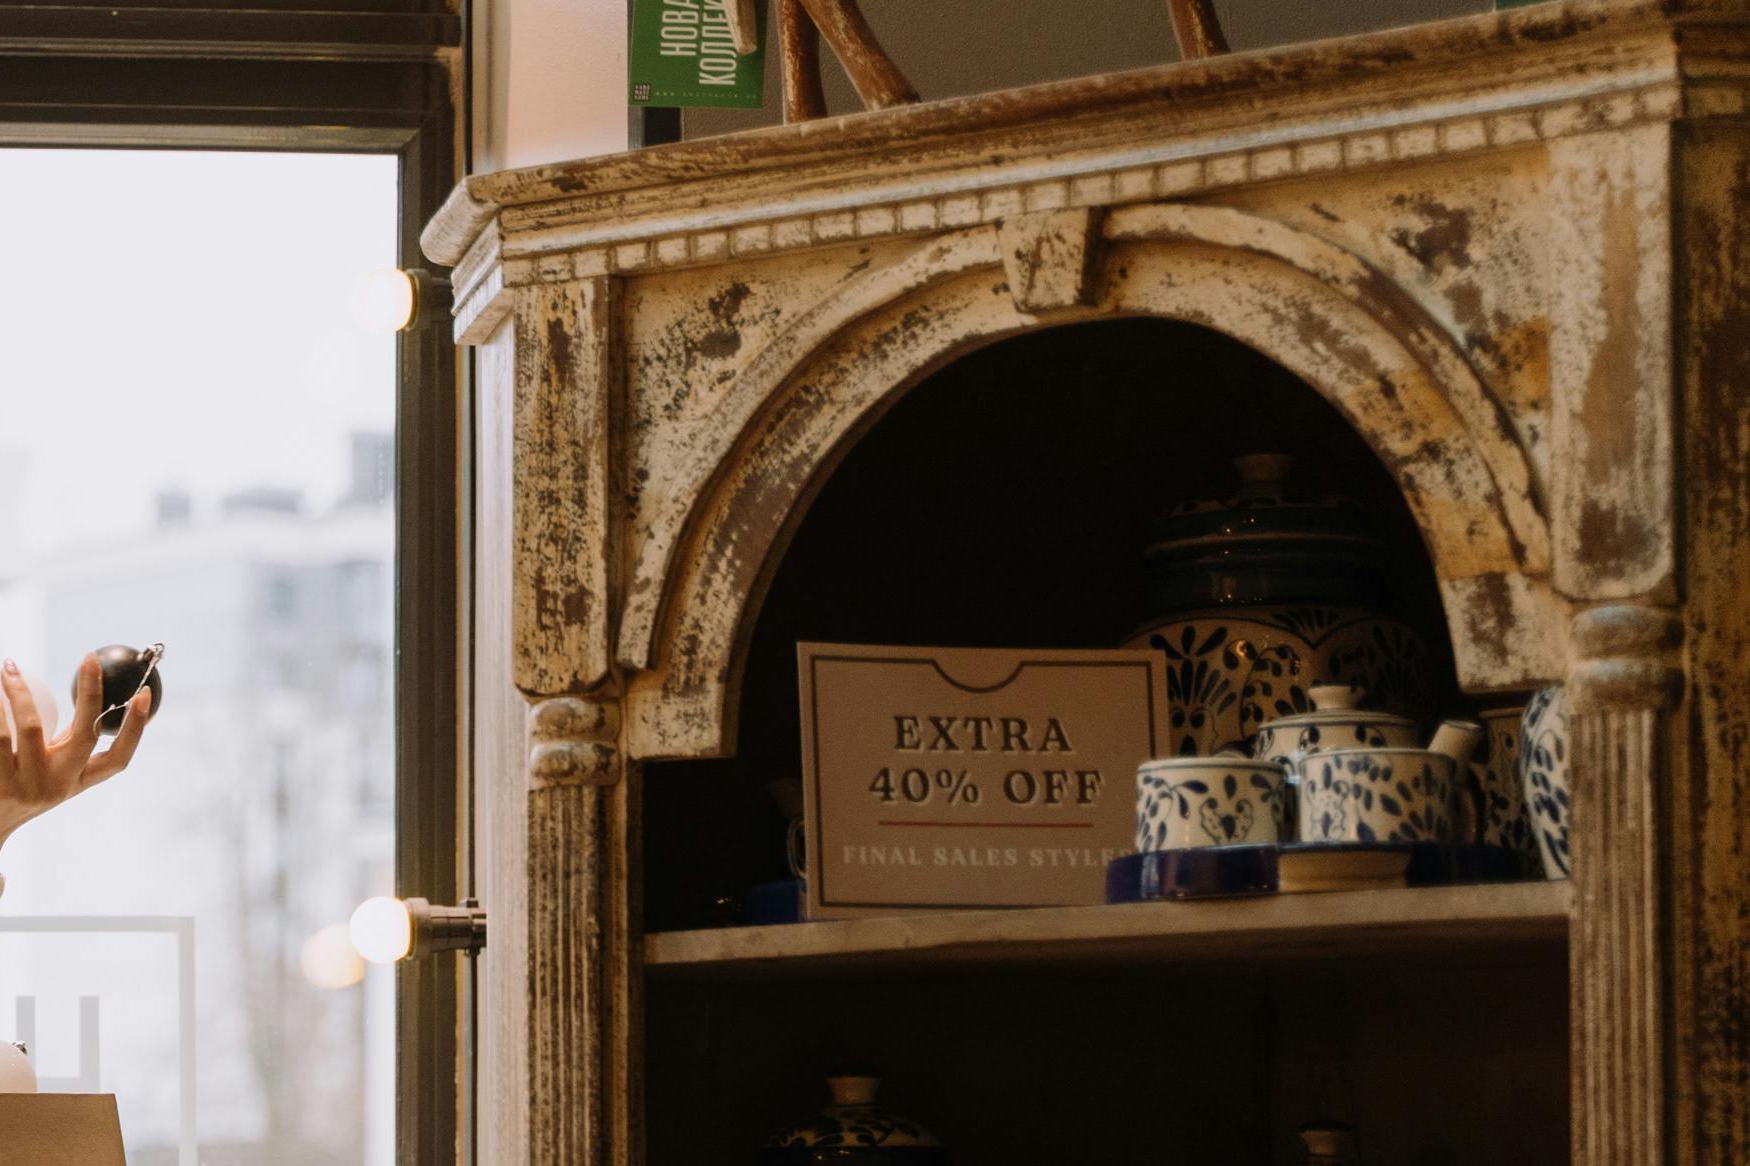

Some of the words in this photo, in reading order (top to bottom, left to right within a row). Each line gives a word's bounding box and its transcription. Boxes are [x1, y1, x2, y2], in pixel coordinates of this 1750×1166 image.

[892, 715, 1074, 754] EXTRA
[868, 766, 981, 807] 40%
[1003, 768, 1106, 807] OFF
[842, 844, 924, 866] FINAL
[933, 847, 1018, 867] SALES
